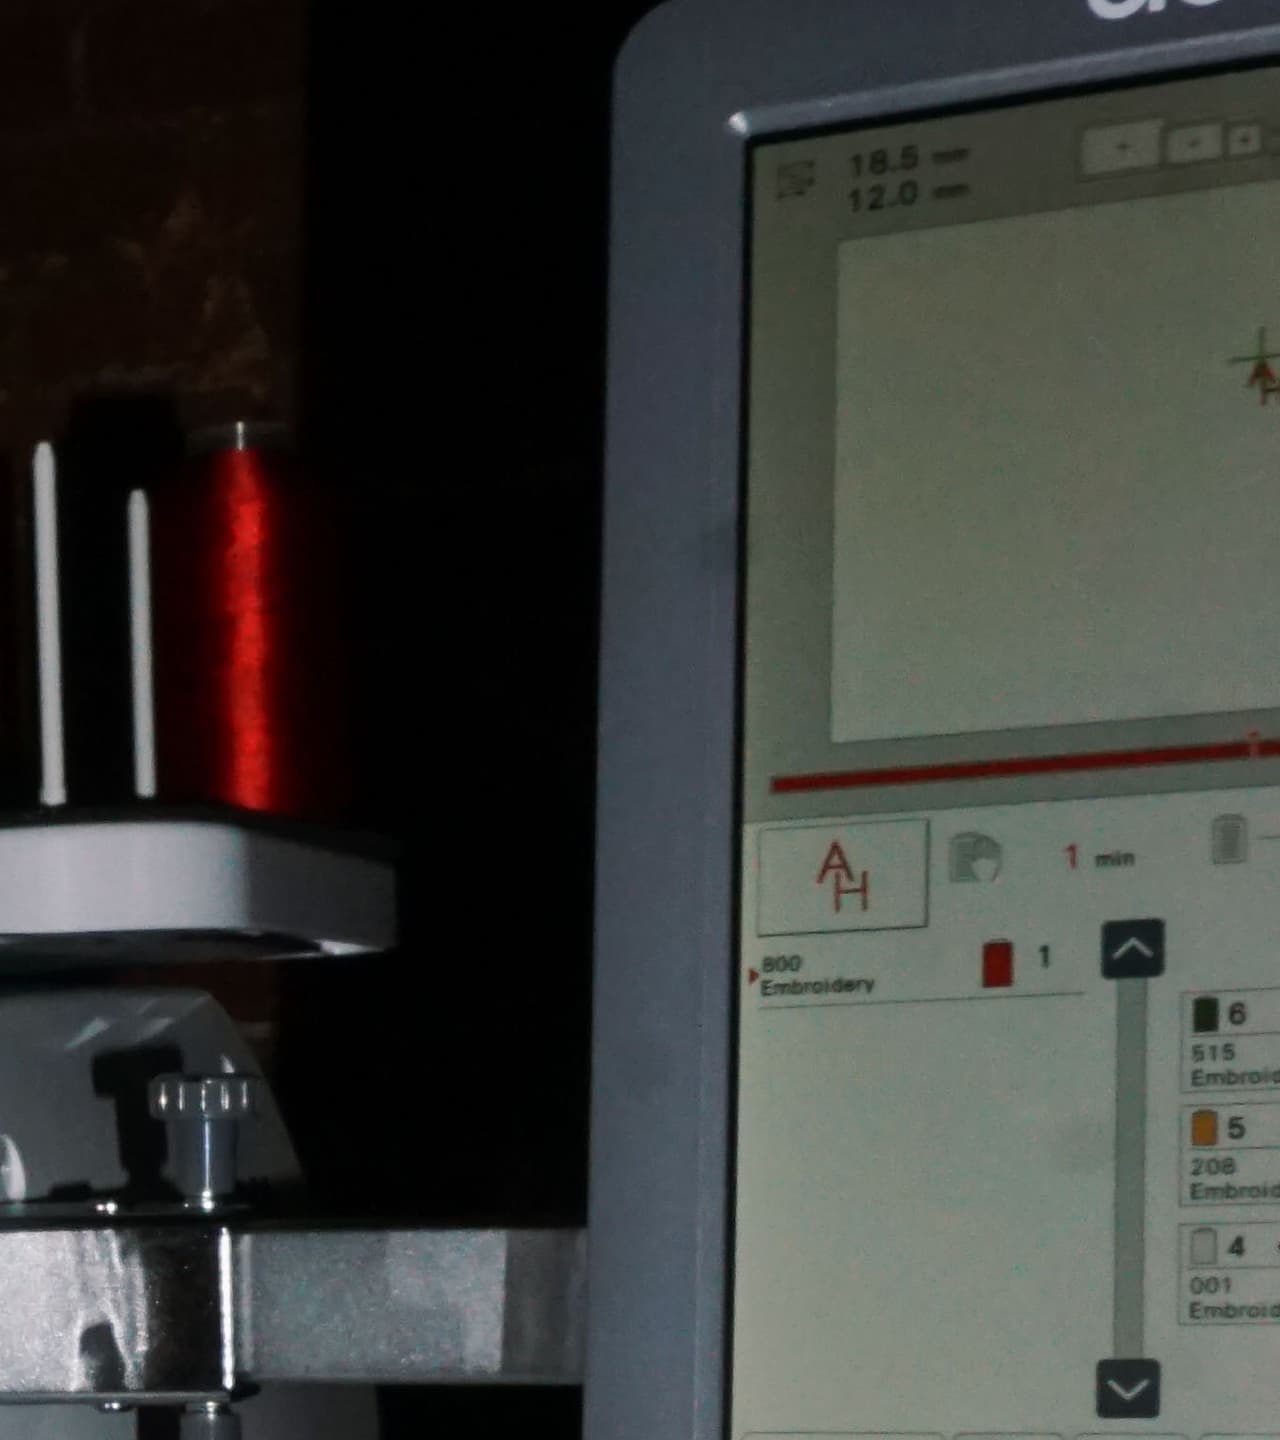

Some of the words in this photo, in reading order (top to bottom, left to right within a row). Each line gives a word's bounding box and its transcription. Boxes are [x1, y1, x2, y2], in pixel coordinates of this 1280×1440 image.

[848, 179, 918, 212] 12.0
[1065, 844, 1077, 869] 1
[1095, 851, 1135, 868] min
[1040, 945, 1049, 968] 1
[760, 978, 875, 997] Embroidery
[1228, 1002, 1246, 1026] 6
[1192, 1043, 1235, 1062] 515
[1228, 1116, 1246, 1140] 5
[1228, 1235, 1245, 1257] 4
[1190, 1276, 1231, 1295] 001
